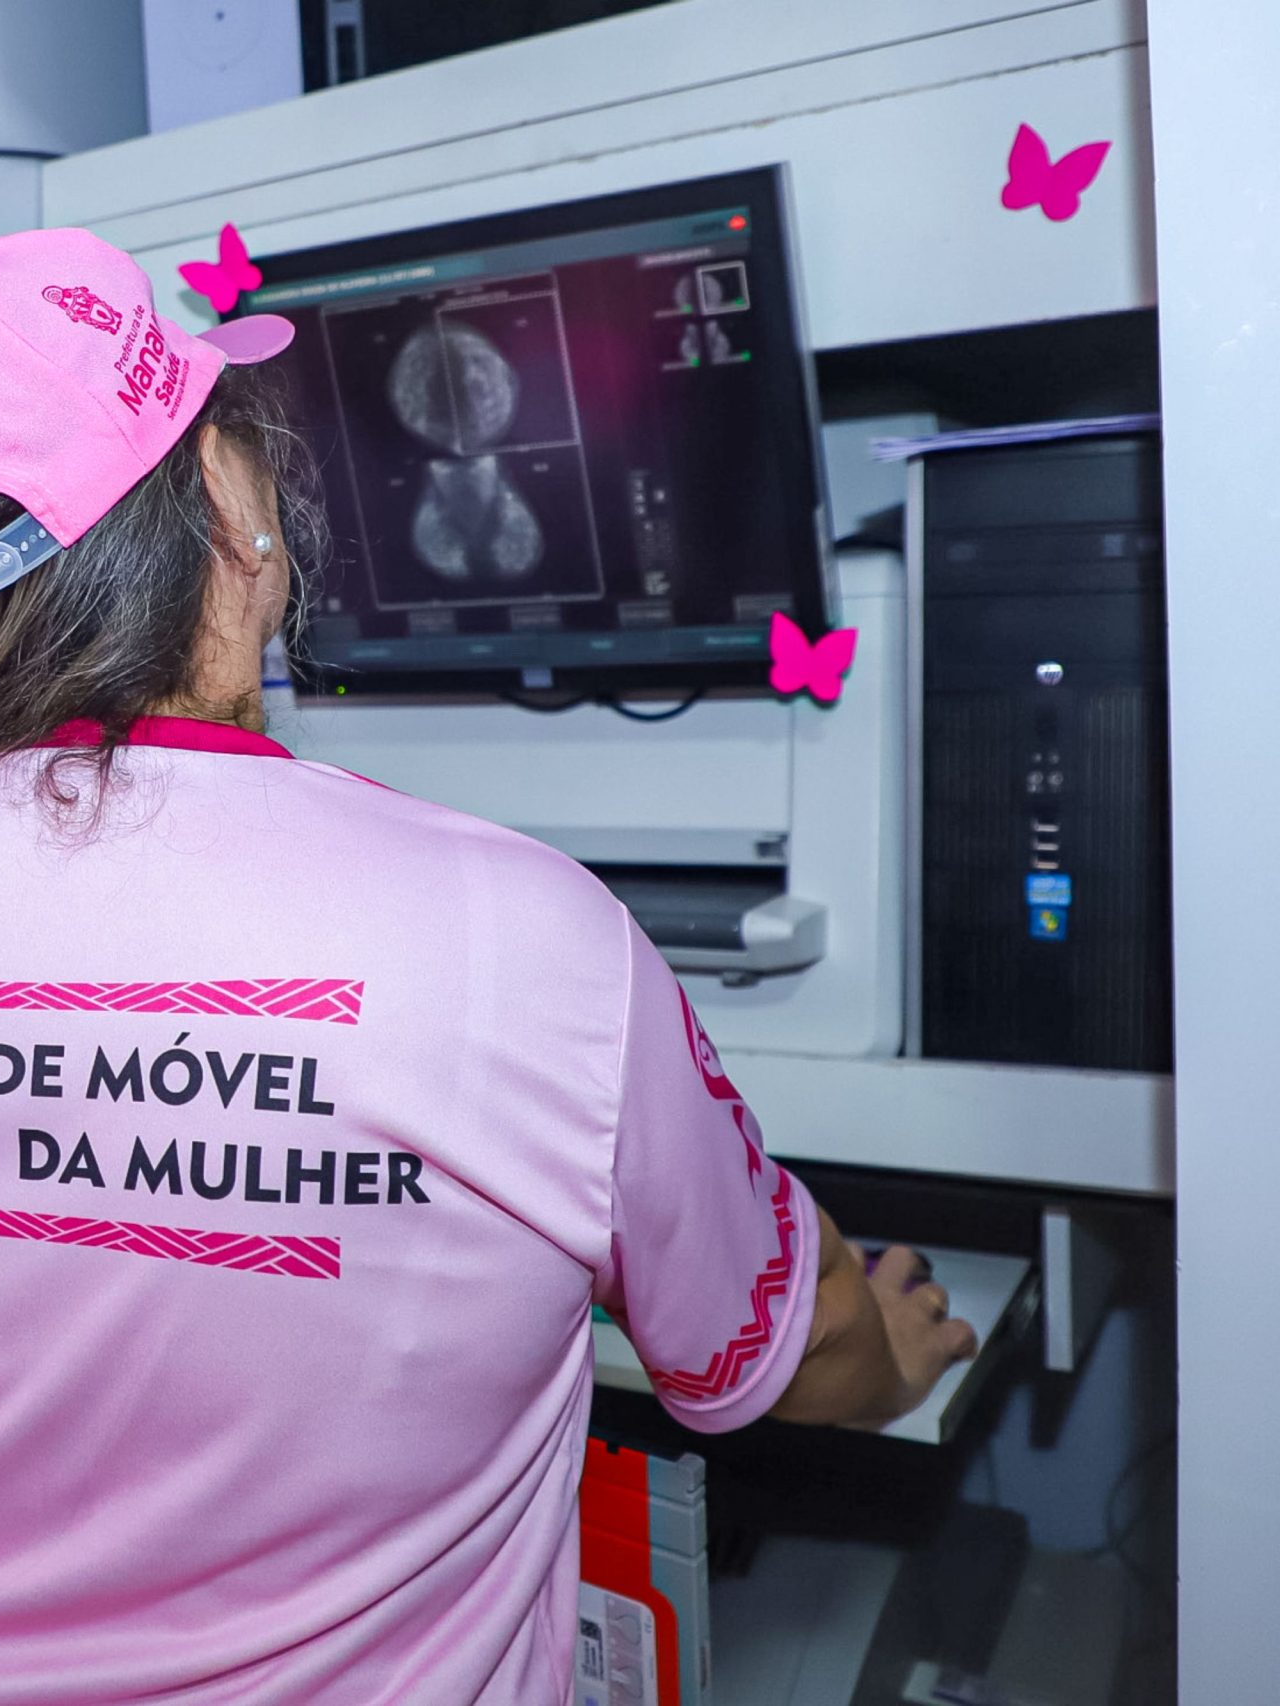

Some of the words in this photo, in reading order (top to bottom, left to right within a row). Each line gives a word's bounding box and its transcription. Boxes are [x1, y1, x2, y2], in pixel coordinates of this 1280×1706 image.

[114, 319, 141, 373] Prefeitura
[133, 304, 145, 320] de
[116, 314, 165, 416] Mana
[155, 352, 180, 407] Saúde
[86, 1032, 335, 1116] MÓVEL
[18, 1128, 106, 1188] DA
[124, 1136, 431, 1205] MULHER
